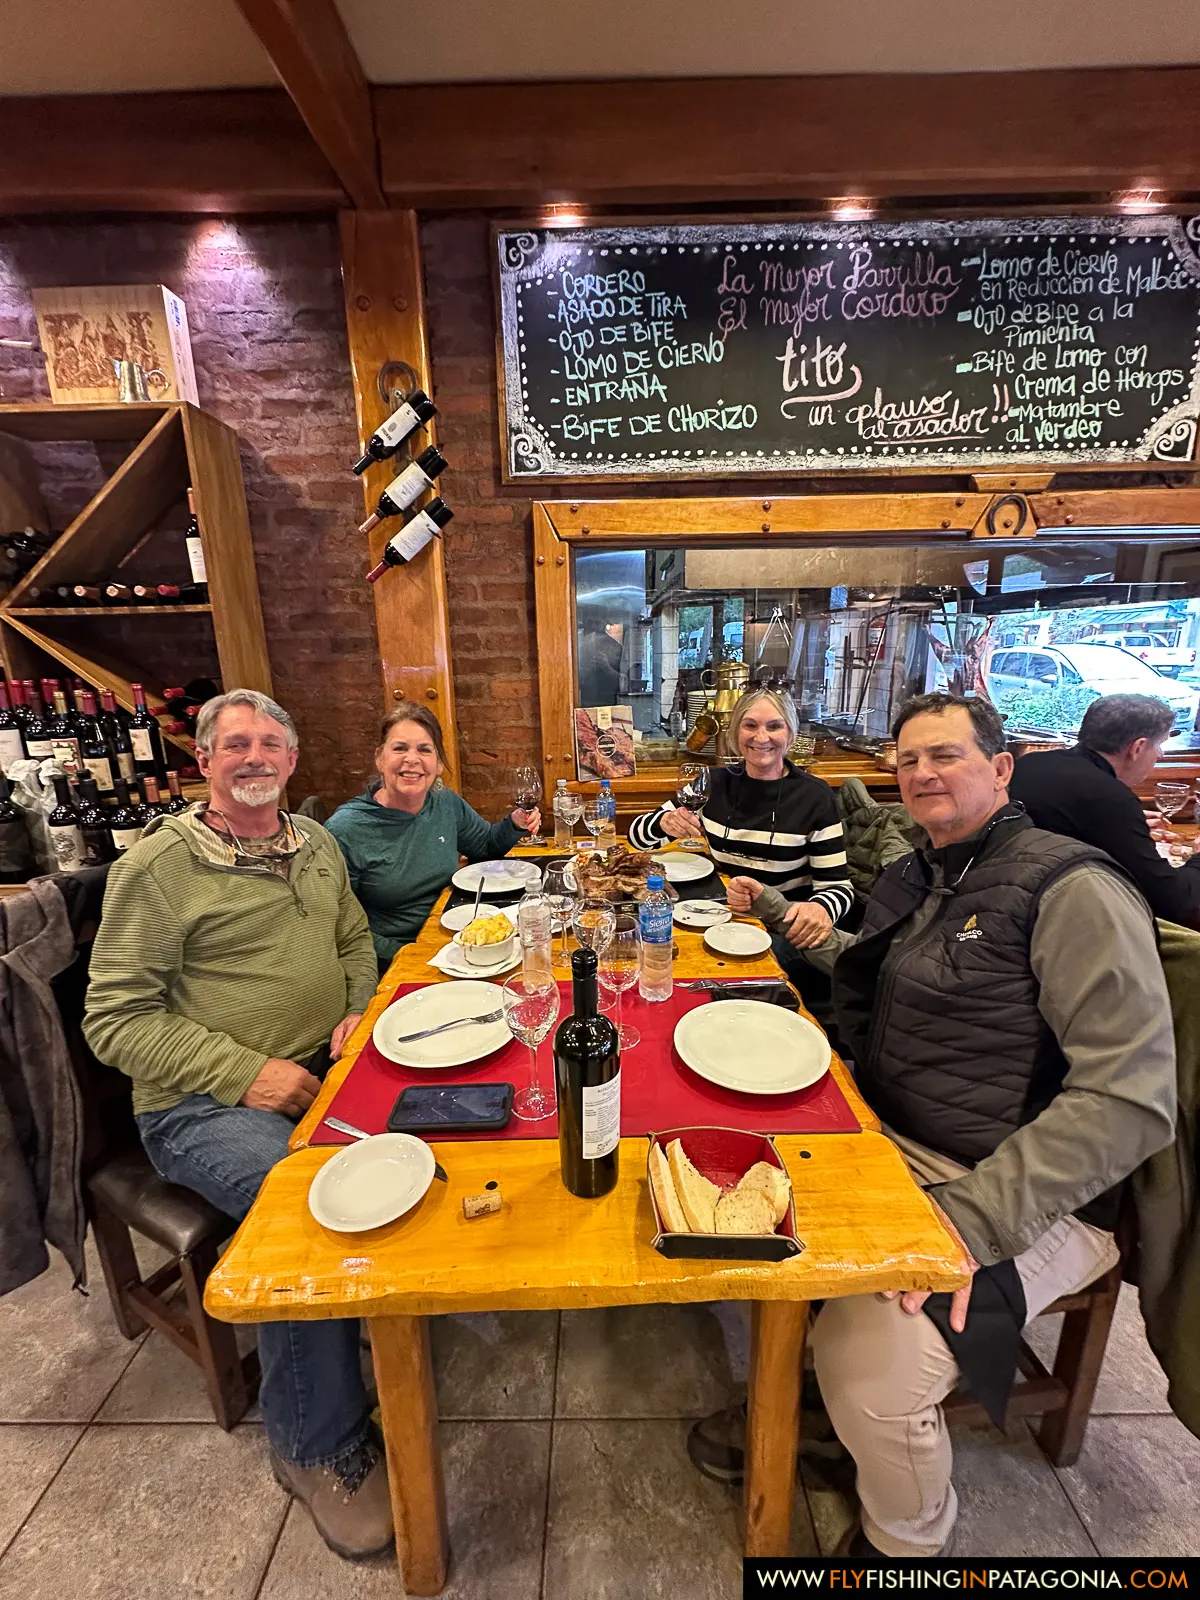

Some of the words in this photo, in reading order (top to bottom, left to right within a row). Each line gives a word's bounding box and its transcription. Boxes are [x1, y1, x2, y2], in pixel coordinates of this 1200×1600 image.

[717, 255, 754, 294] La
[843, 247, 962, 290] Parrilla
[978, 247, 1034, 281] Lomo
[1037, 246, 1061, 277] de
[981, 281, 1001, 301] en
[1099, 274, 1123, 294] de
[1126, 257, 1189, 297] Malbec
[562, 269, 645, 299] CORDERO
[558, 298, 615, 333] ASADO
[619, 296, 643, 316] DE
[717, 297, 747, 341] El
[841, 287, 959, 320] Cordero
[1011, 301, 1032, 322] de
[1035, 302, 1079, 330] Bife
[1088, 306, 1103, 322] a
[1113, 296, 1133, 319] la
[560, 329, 594, 358] OJO
[600, 325, 626, 344] DE
[1003, 324, 1095, 347] Pimienta
[564, 353, 617, 381] LOMO
[623, 349, 652, 374] DE
[776, 335, 847, 392] tito
[972, 350, 1015, 377] Bife
[1022, 347, 1047, 371] de
[1055, 345, 1106, 368] Lomo
[565, 372, 667, 406] ENTRAÑA
[1015, 373, 1075, 400] Crema
[1082, 367, 1110, 393] de
[1115, 367, 1184, 405] Hongos
[629, 414, 663, 435] DE
[808, 404, 836, 426] un
[845, 386, 952, 435] aplauso
[1019, 395, 1124, 423] Matambre
[862, 421, 888, 439] al
